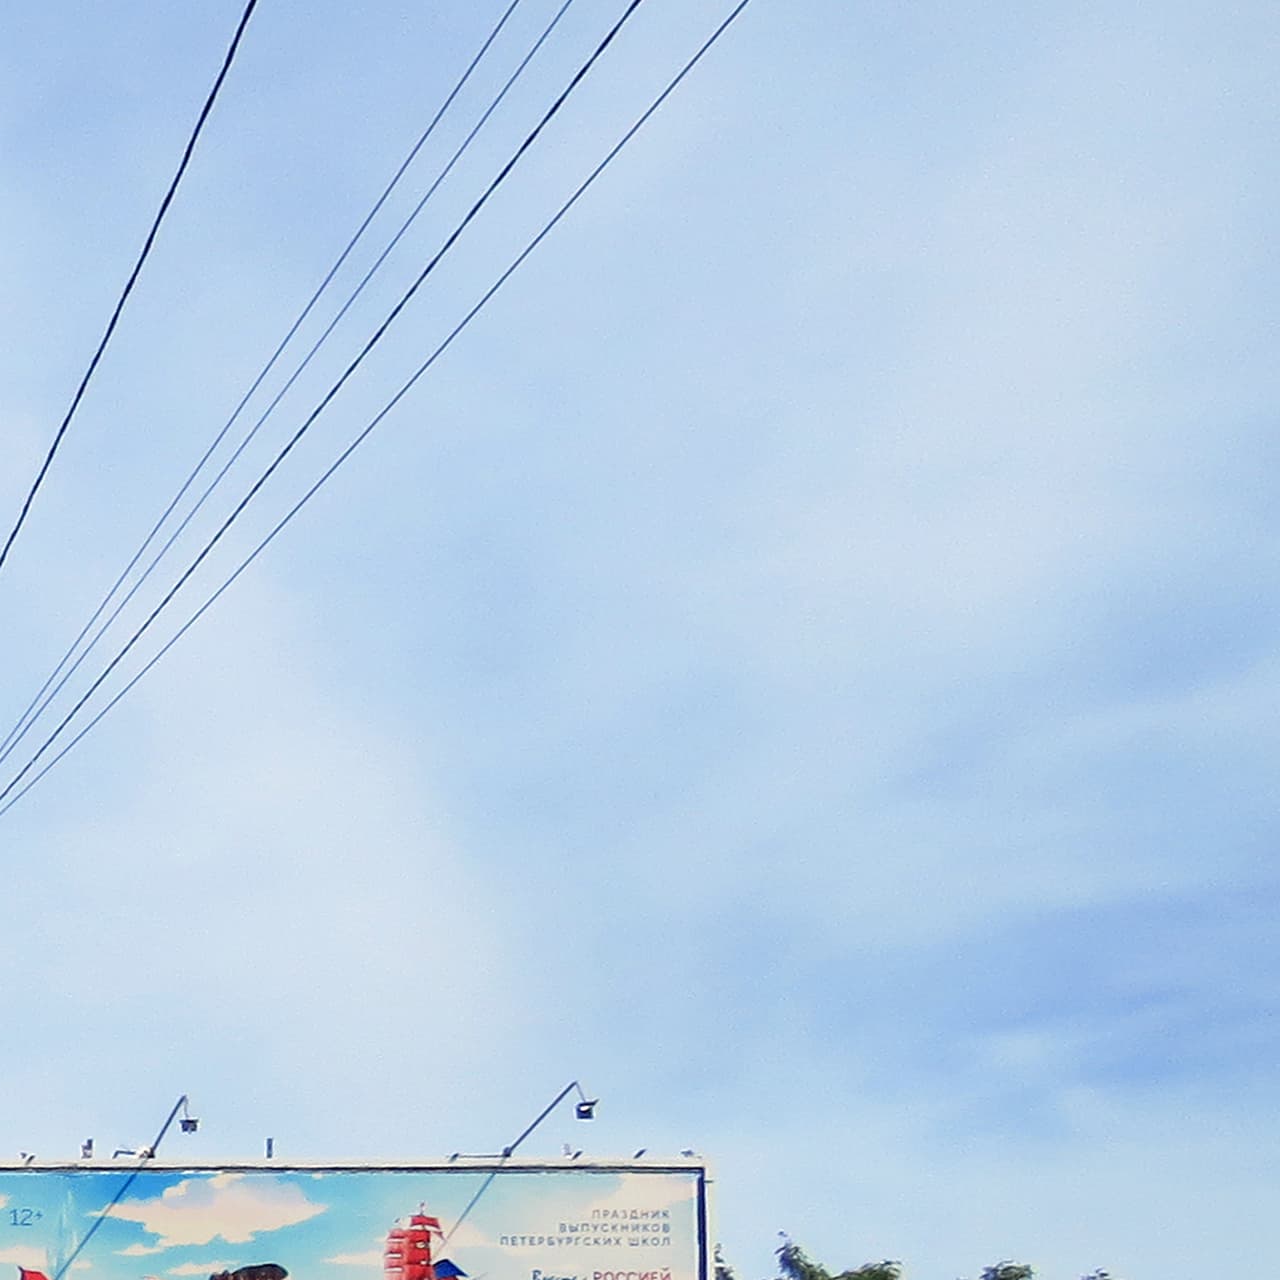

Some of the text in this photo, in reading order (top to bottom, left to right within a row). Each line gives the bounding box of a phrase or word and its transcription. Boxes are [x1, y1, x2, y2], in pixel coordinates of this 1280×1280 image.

[9, 1208, 44, 1226] 12+
[591, 1209, 671, 1220] ПРАЗДНИК
[558, 1222, 672, 1233] ВЫПУСКНИКОВ
[499, 1235, 672, 1247] ПЕТЕРБУРГСКИХ ШКОЛ
